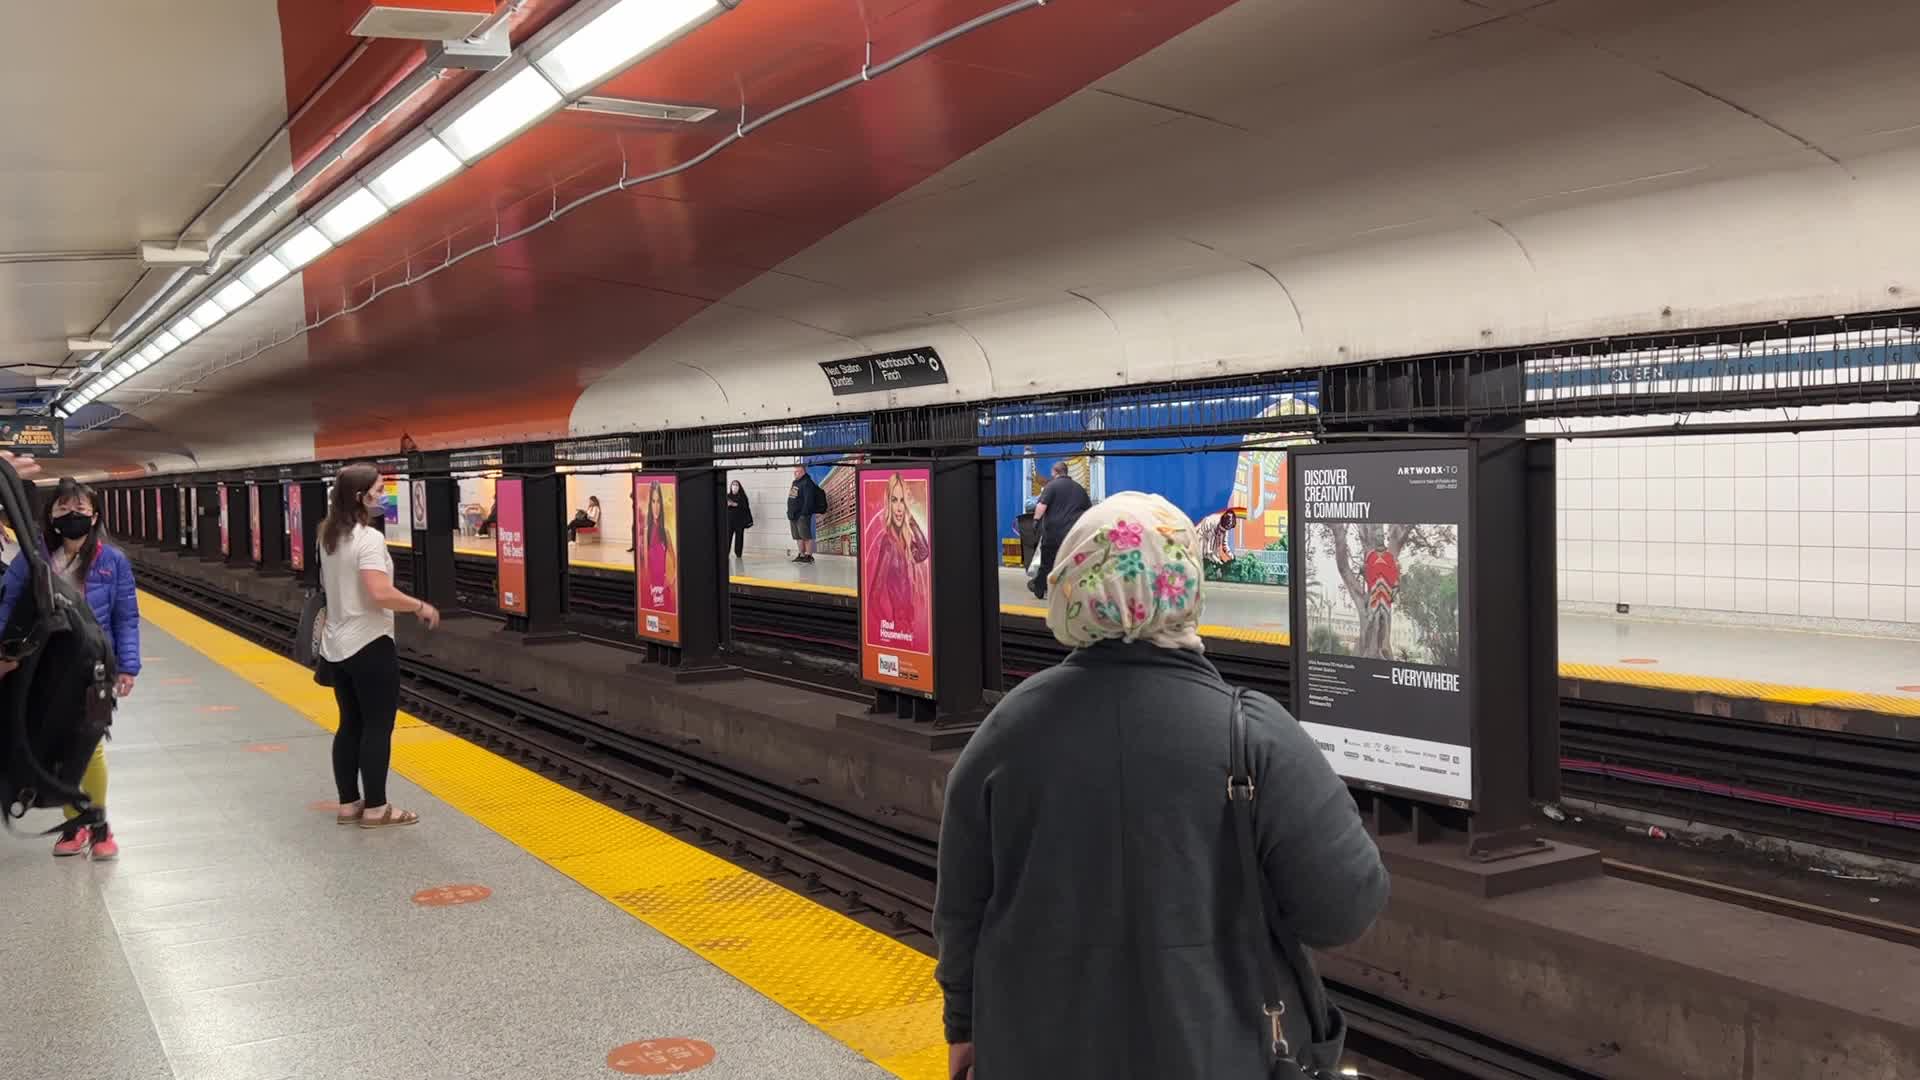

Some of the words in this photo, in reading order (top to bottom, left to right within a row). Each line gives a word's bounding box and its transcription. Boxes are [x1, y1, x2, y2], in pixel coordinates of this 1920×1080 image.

[876, 355, 914, 369] Northbound
[914, 353, 926, 363] To
[825, 366, 841, 375] Next
[841, 363, 862, 374] Station
[882, 370, 901, 381] Finch
[831, 376, 854, 387] Dundas
[1304, 469, 1348, 486] DISCOVER
[1304, 485, 1355, 502] CREATIVITY
[1304, 503, 1311, 518] &
[1313, 502, 1371, 519] COMMUNITY
[880, 619, 894, 630] Real
[880, 629, 913, 642] Housewives
